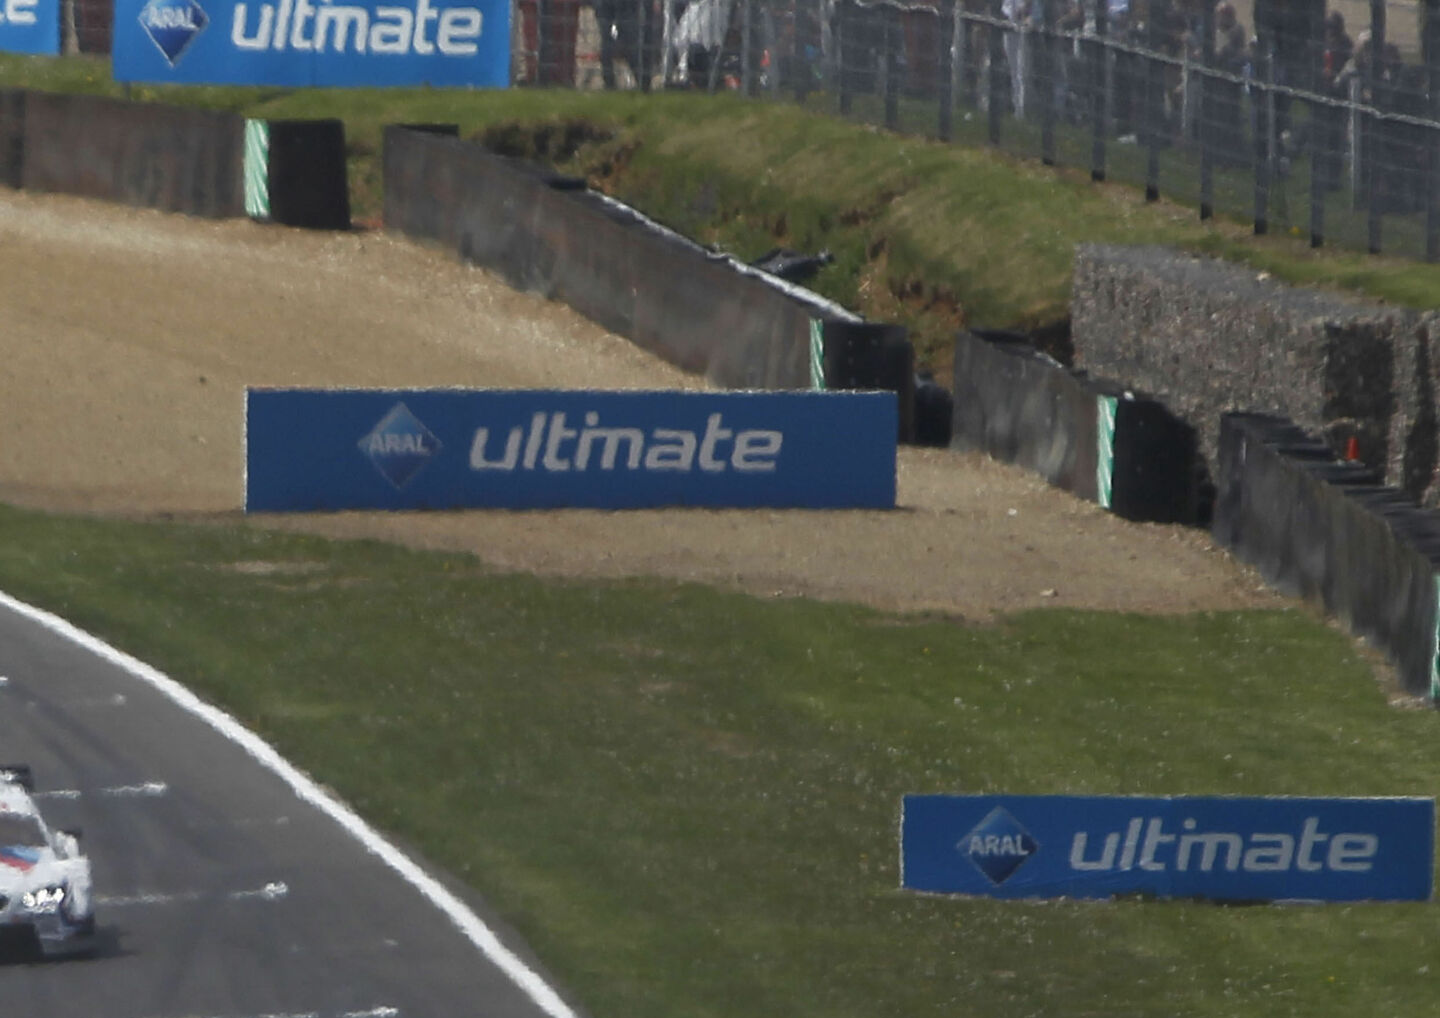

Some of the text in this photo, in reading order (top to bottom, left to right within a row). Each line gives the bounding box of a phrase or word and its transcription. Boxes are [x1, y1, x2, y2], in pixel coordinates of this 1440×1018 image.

[232, 0, 483, 55] ultimate
[369, 410, 783, 471] ARAL ultimate
[968, 816, 1379, 872] ARAL ultimate
